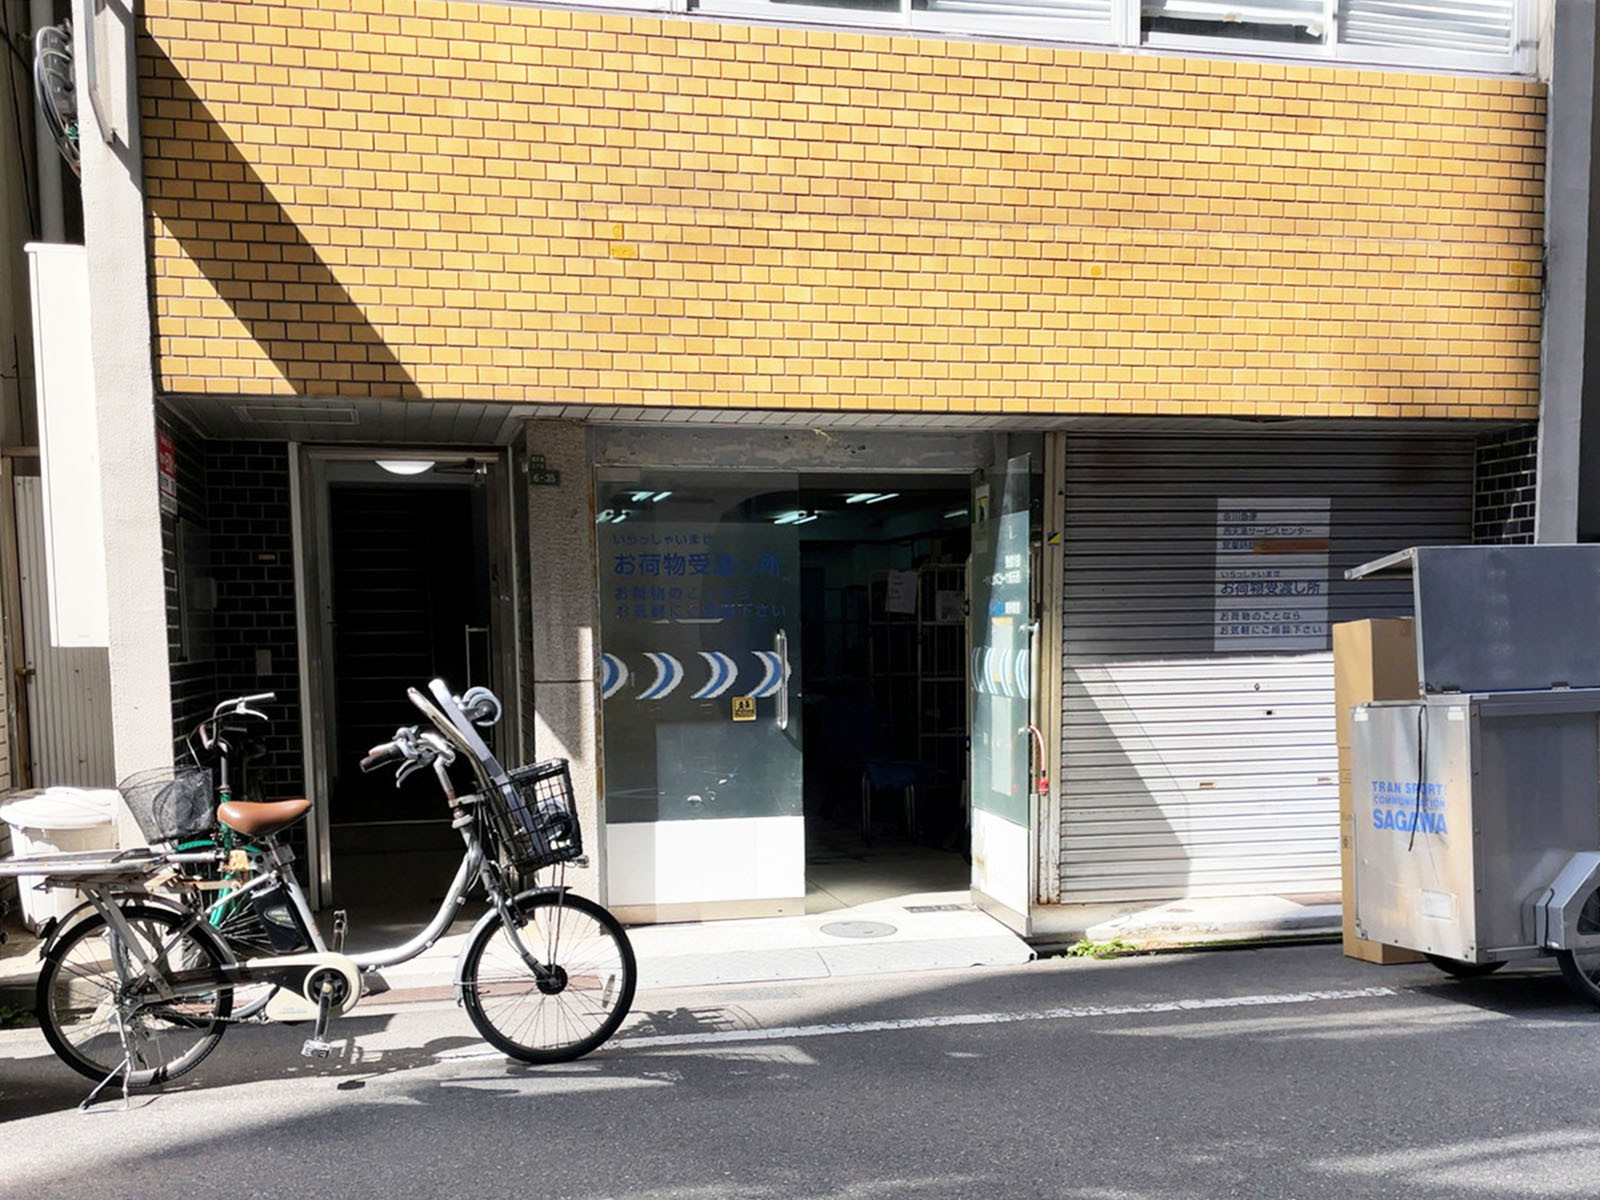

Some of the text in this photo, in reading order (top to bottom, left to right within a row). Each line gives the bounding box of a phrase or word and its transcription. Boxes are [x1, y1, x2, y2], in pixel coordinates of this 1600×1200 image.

[1220, 581, 1321, 596] お荷物受渡し所
[1372, 808, 1449, 835] SAGAWA
